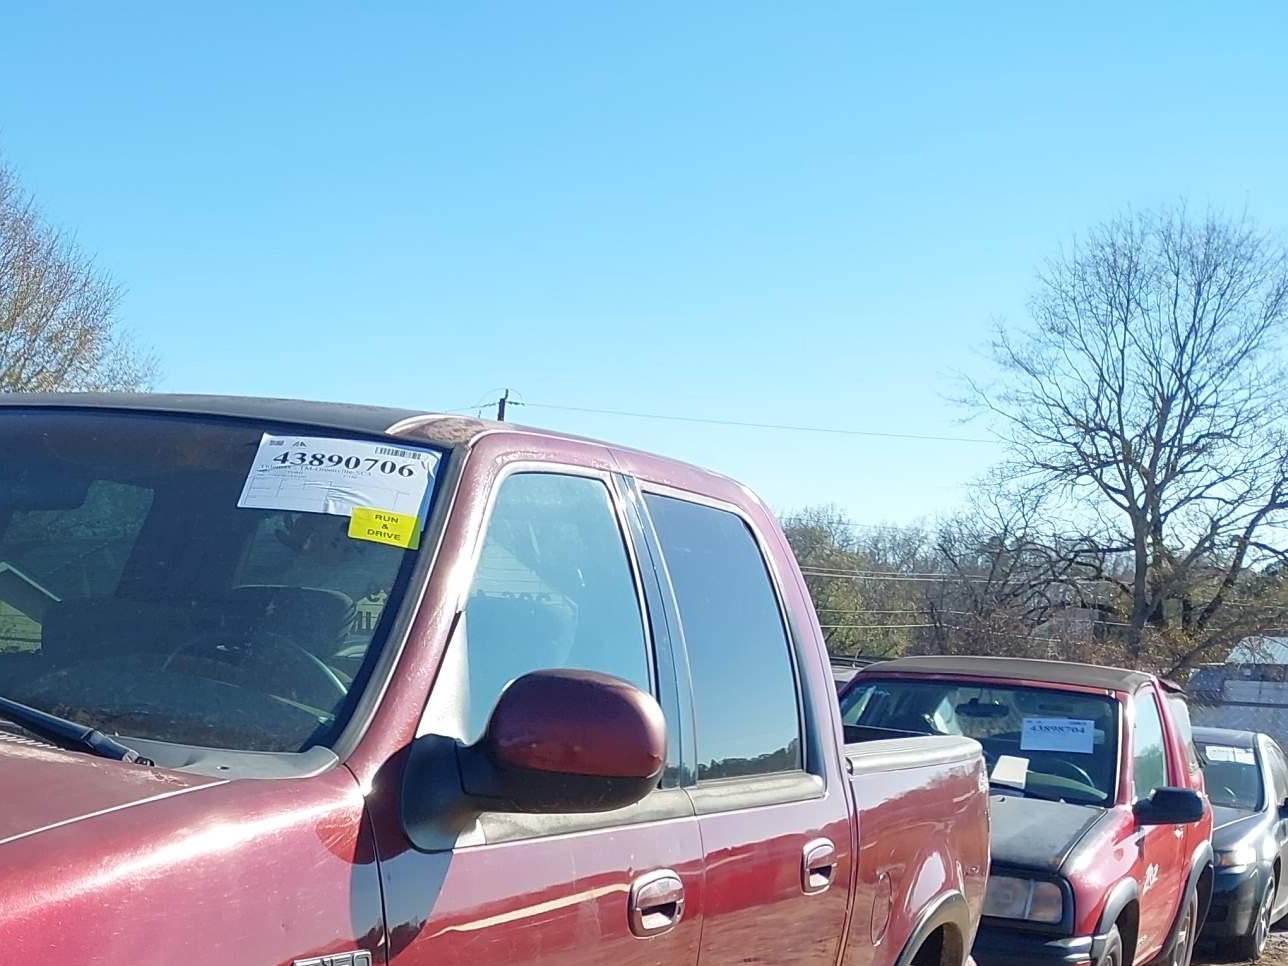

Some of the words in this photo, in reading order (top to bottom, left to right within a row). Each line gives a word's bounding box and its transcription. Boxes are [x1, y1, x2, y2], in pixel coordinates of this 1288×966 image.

[272, 451, 415, 478] 43890706
[374, 514, 399, 523] RUN
[367, 528, 401, 541] DRIVE
